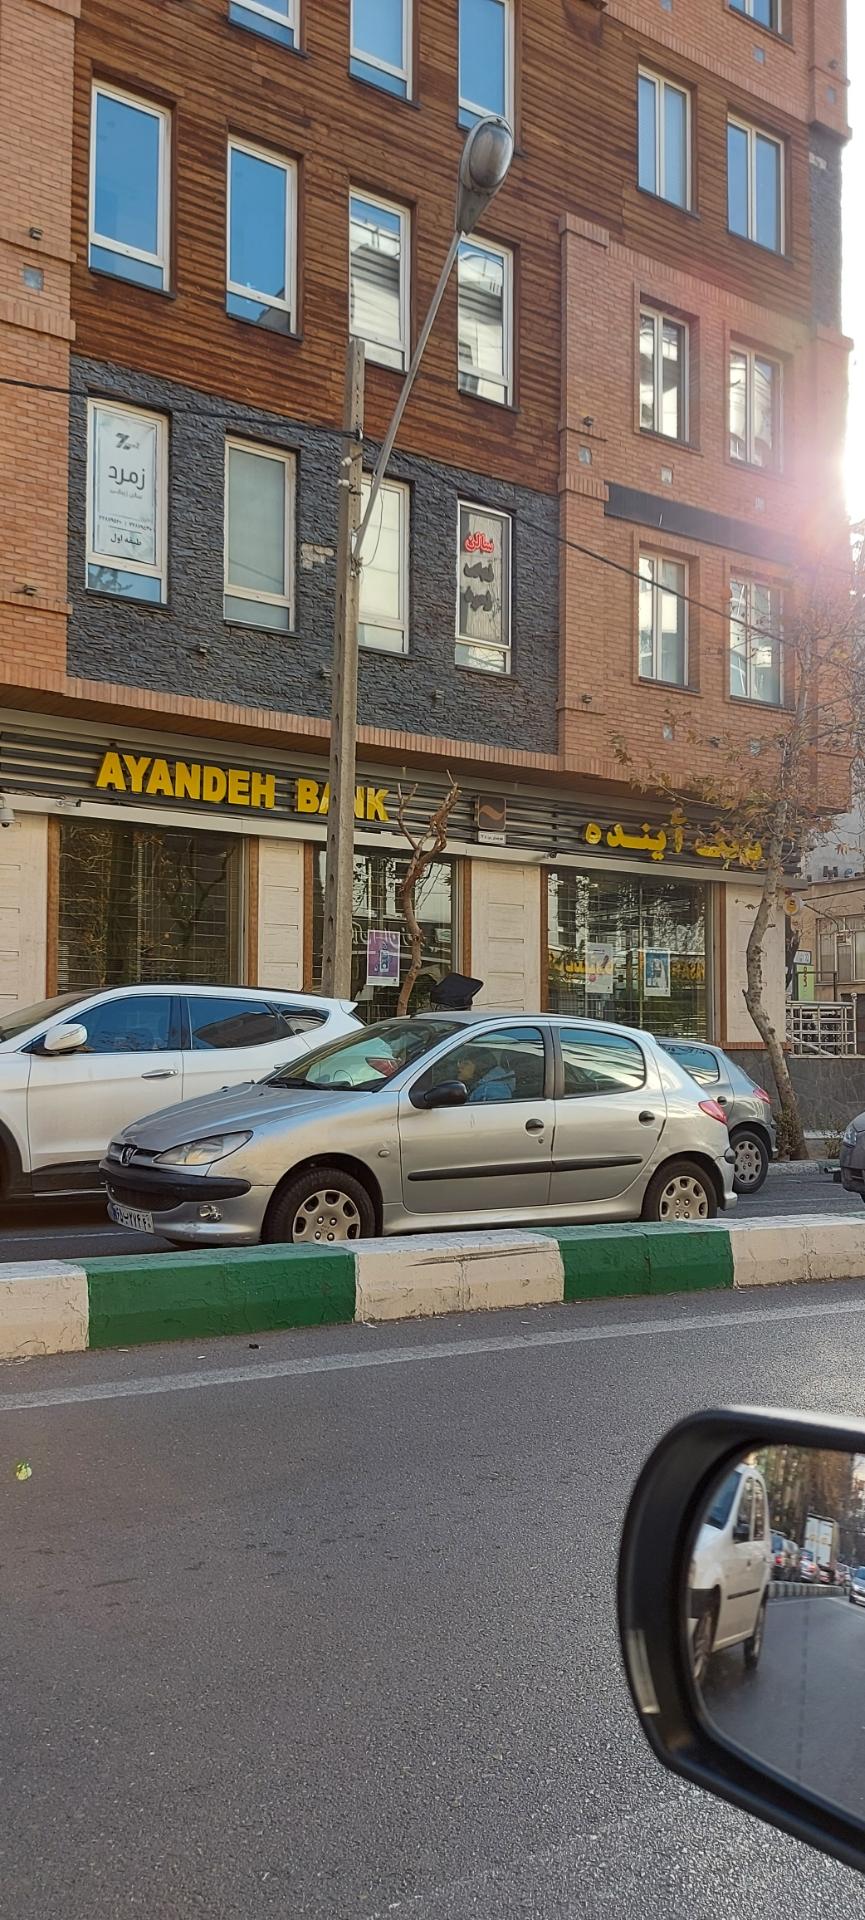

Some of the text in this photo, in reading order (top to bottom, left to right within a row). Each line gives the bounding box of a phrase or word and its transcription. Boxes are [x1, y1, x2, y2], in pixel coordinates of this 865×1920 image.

[108, 465, 146, 490] زمرد
[110, 532, 142, 546] طبقه اول
[464, 532, 495, 553] سالن
[96, 751, 276, 809] AYANDEH
